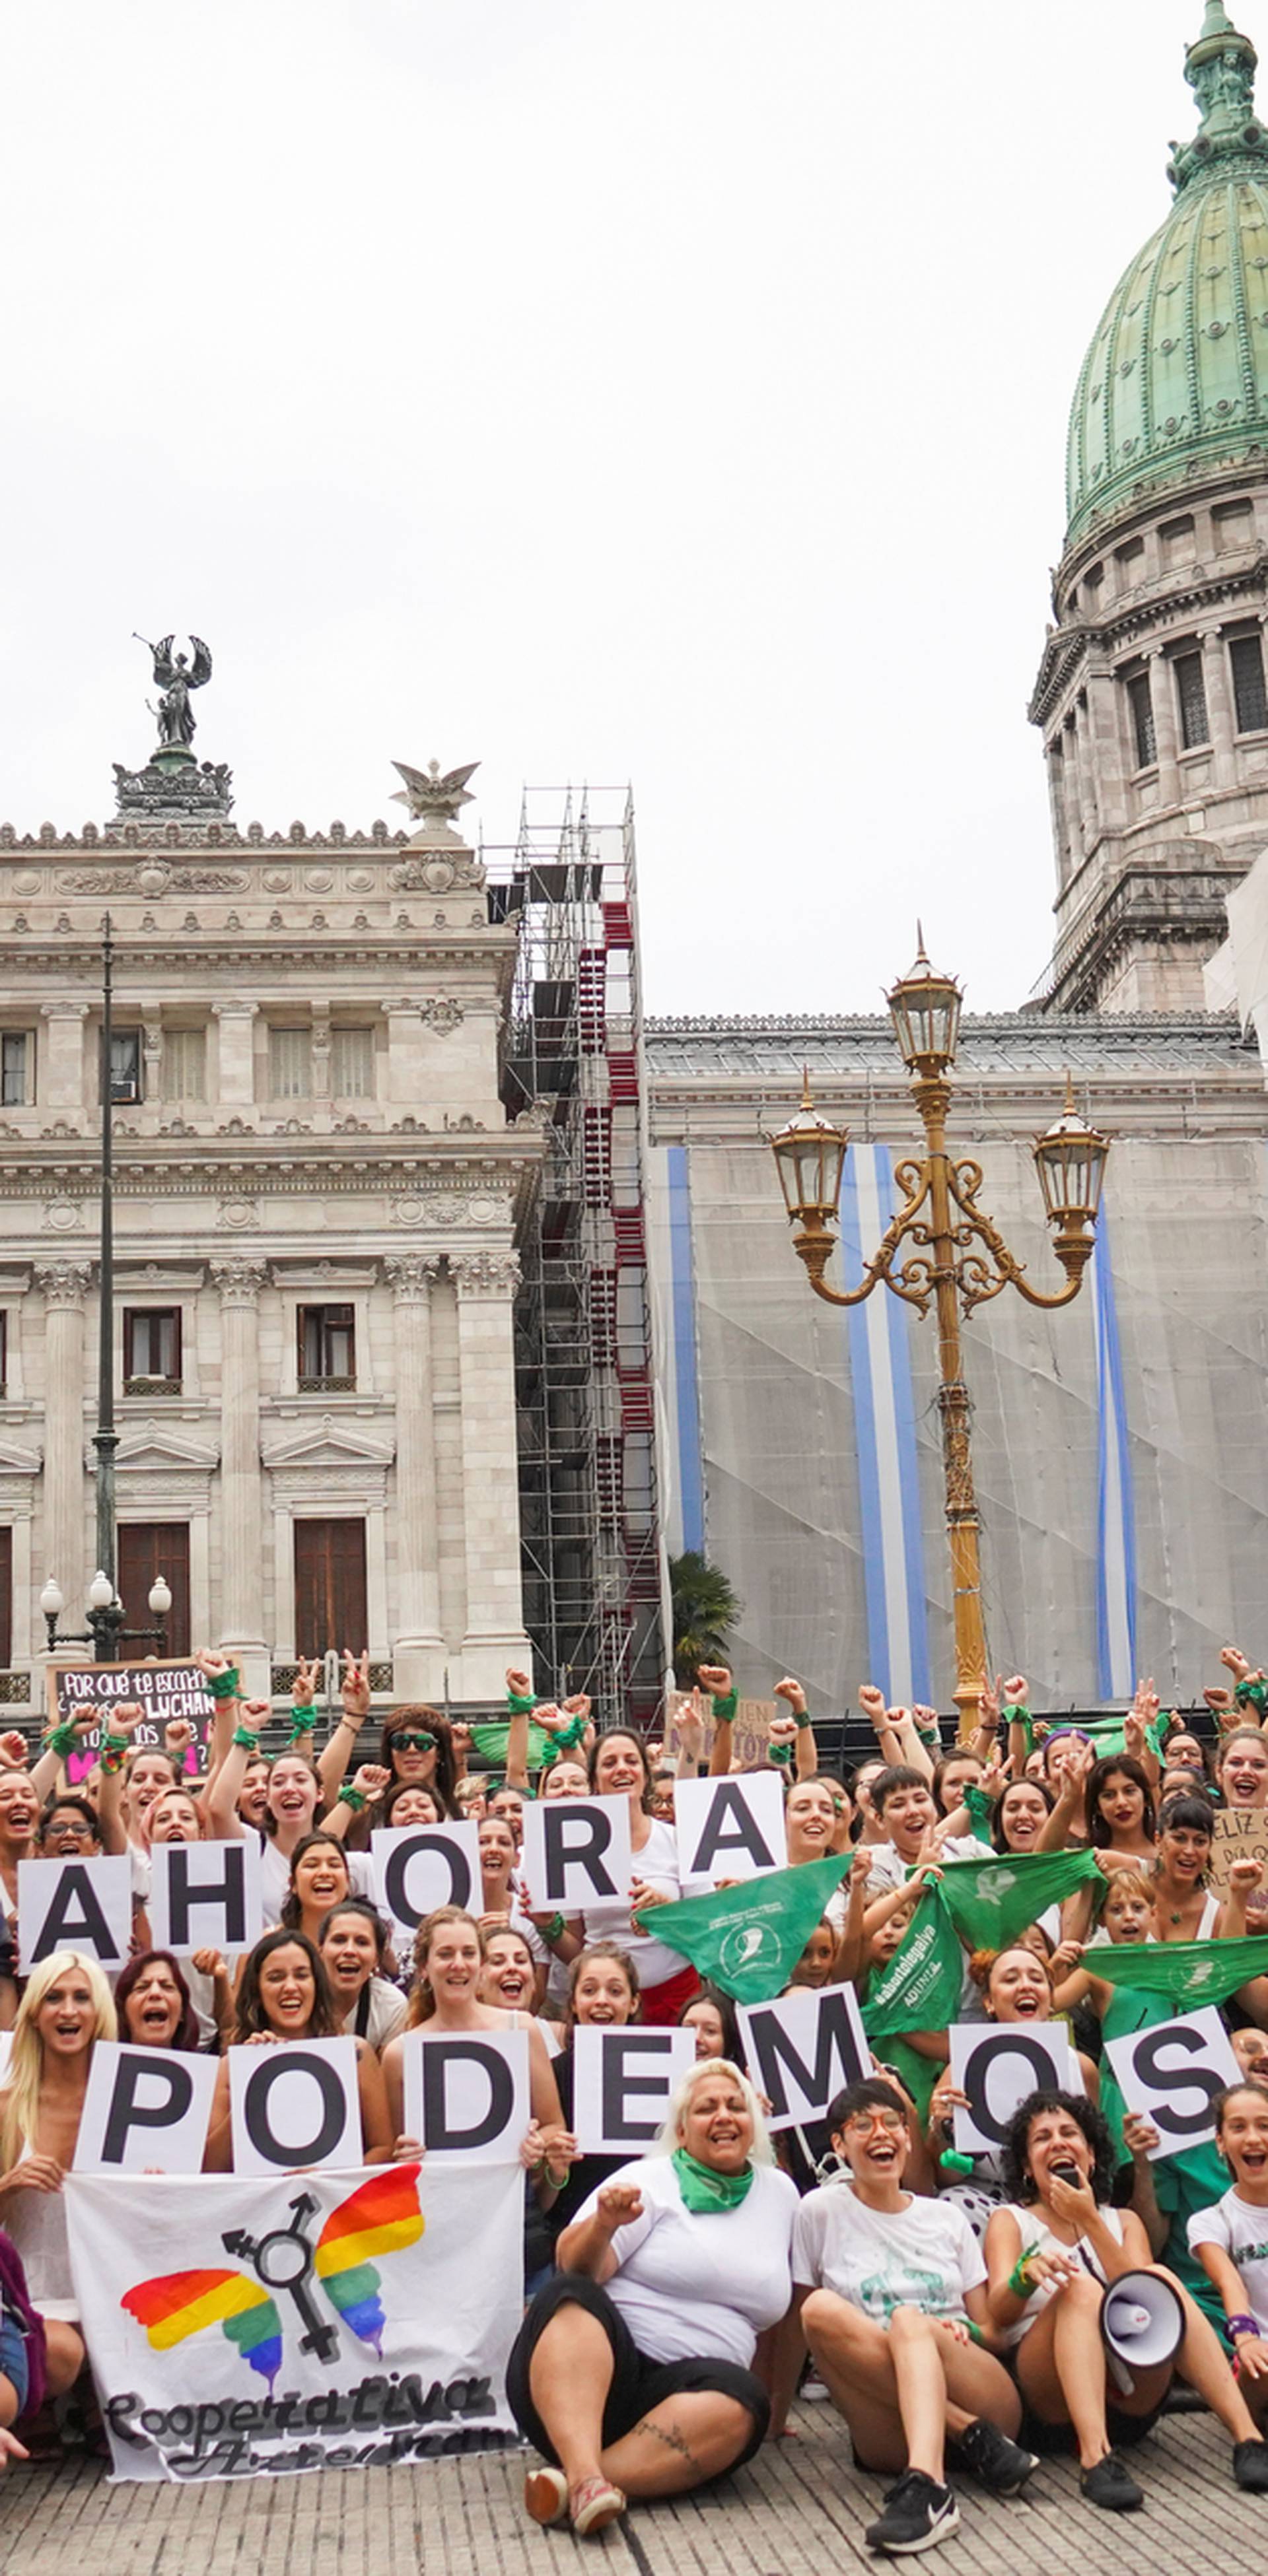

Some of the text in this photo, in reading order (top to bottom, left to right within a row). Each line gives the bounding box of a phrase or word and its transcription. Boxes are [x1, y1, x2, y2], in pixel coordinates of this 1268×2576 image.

[132, 1673, 153, 1695] te
[874, 1924, 936, 2006] #abortolegalya
[104, 2373, 494, 2462] Cooperativa
